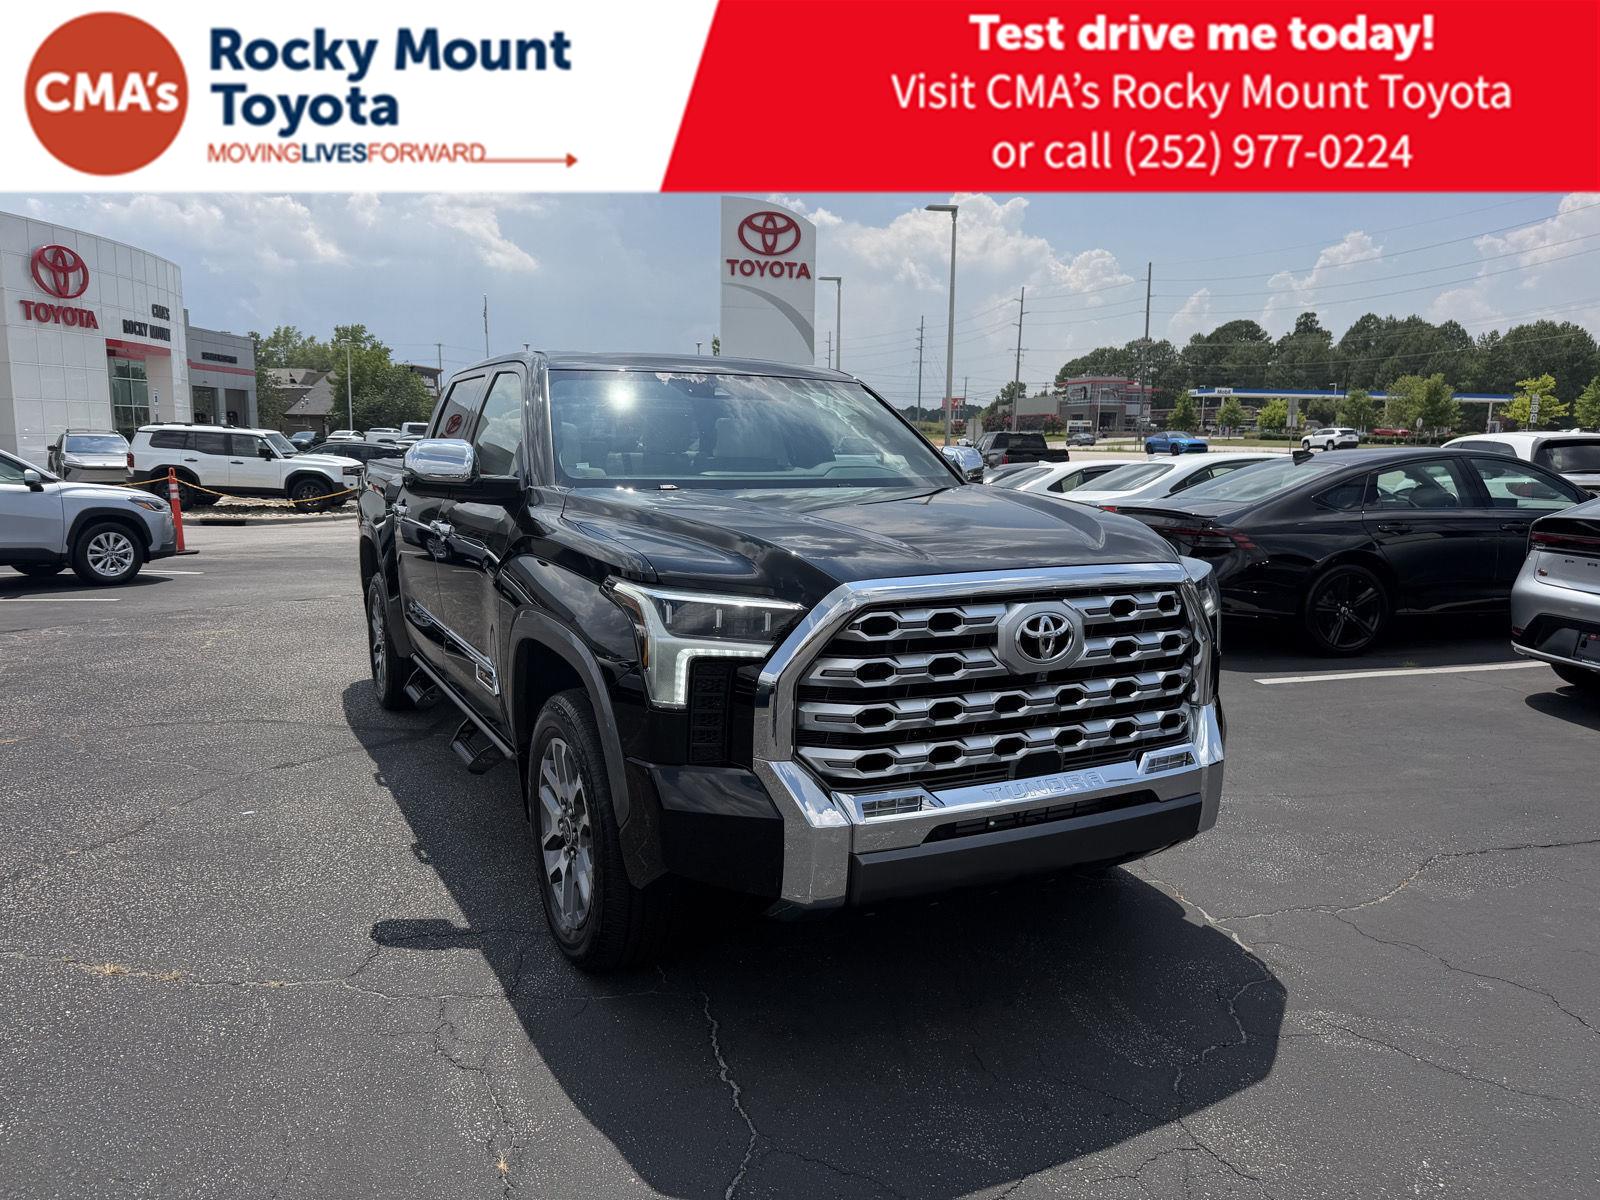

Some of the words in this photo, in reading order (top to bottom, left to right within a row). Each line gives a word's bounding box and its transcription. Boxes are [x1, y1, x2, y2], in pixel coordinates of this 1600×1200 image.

[726, 259, 811, 280] TOYOTA
[19, 299, 99, 330] TOYOTA
[122, 318, 148, 338] ROCKY
[1216, 388, 1232, 396] Mobil
[983, 771, 1106, 802] TUNDRA
